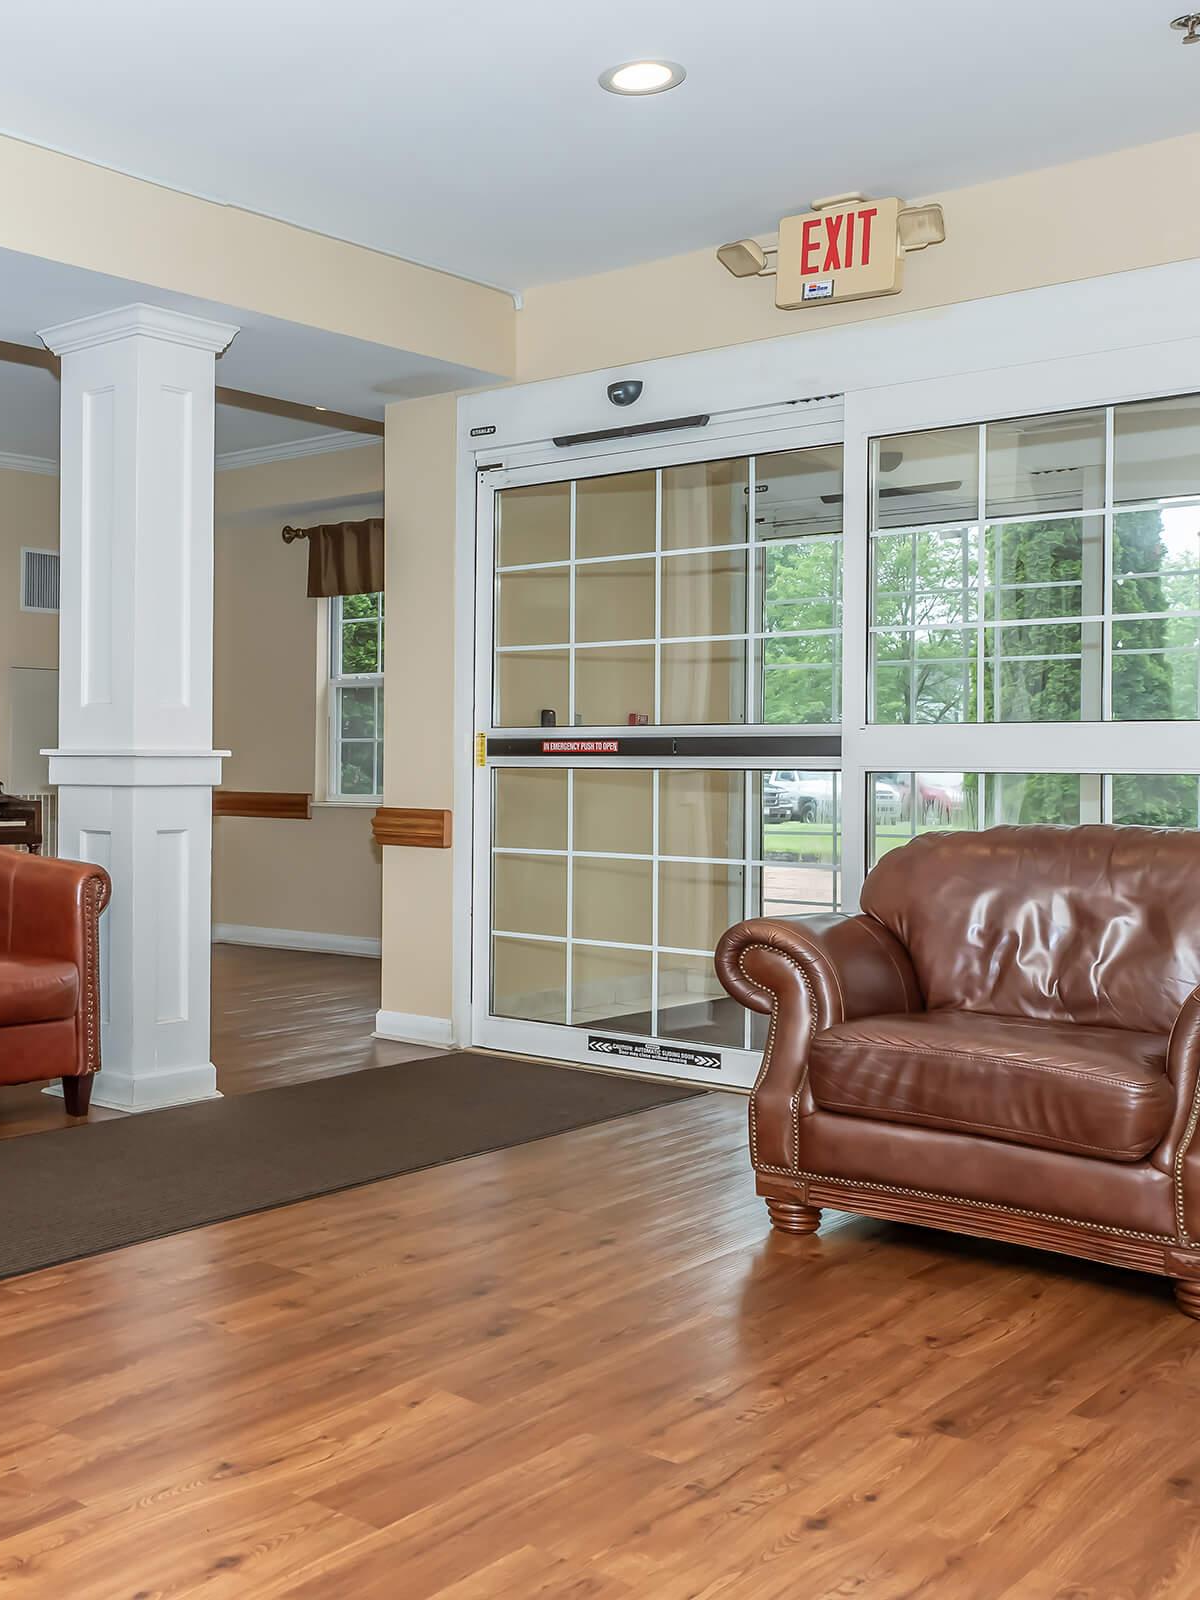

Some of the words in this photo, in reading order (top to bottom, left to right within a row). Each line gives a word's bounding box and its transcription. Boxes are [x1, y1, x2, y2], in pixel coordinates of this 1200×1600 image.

[800, 208, 877, 275] EXIT
[550, 742, 580, 750] EMERGENCY
[581, 742, 594, 750] PUSH
[595, 742, 602, 750] TO
[603, 742, 617, 751] OPEN
